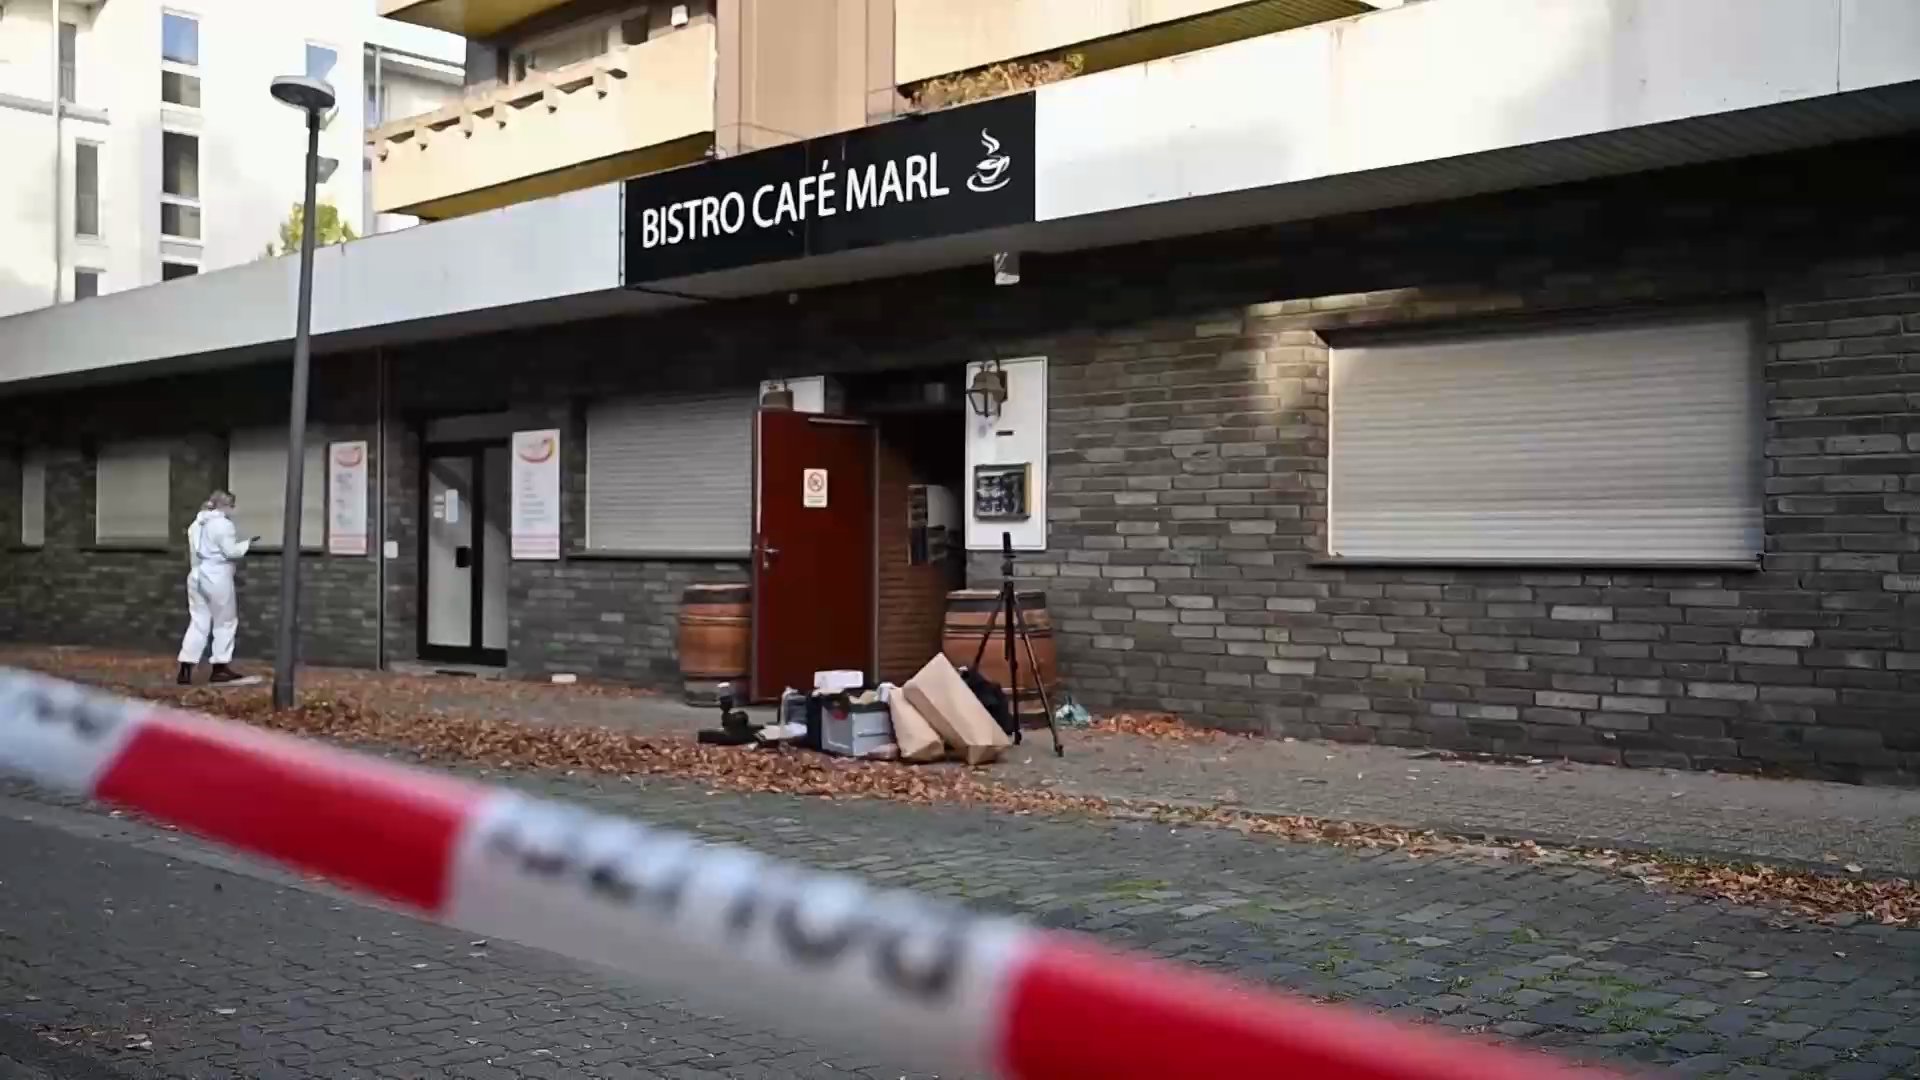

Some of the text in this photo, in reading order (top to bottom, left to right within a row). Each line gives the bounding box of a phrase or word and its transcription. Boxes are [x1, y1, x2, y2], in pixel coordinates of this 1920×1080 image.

[642, 152, 950, 249] BISTRO CAFÉ MARL
